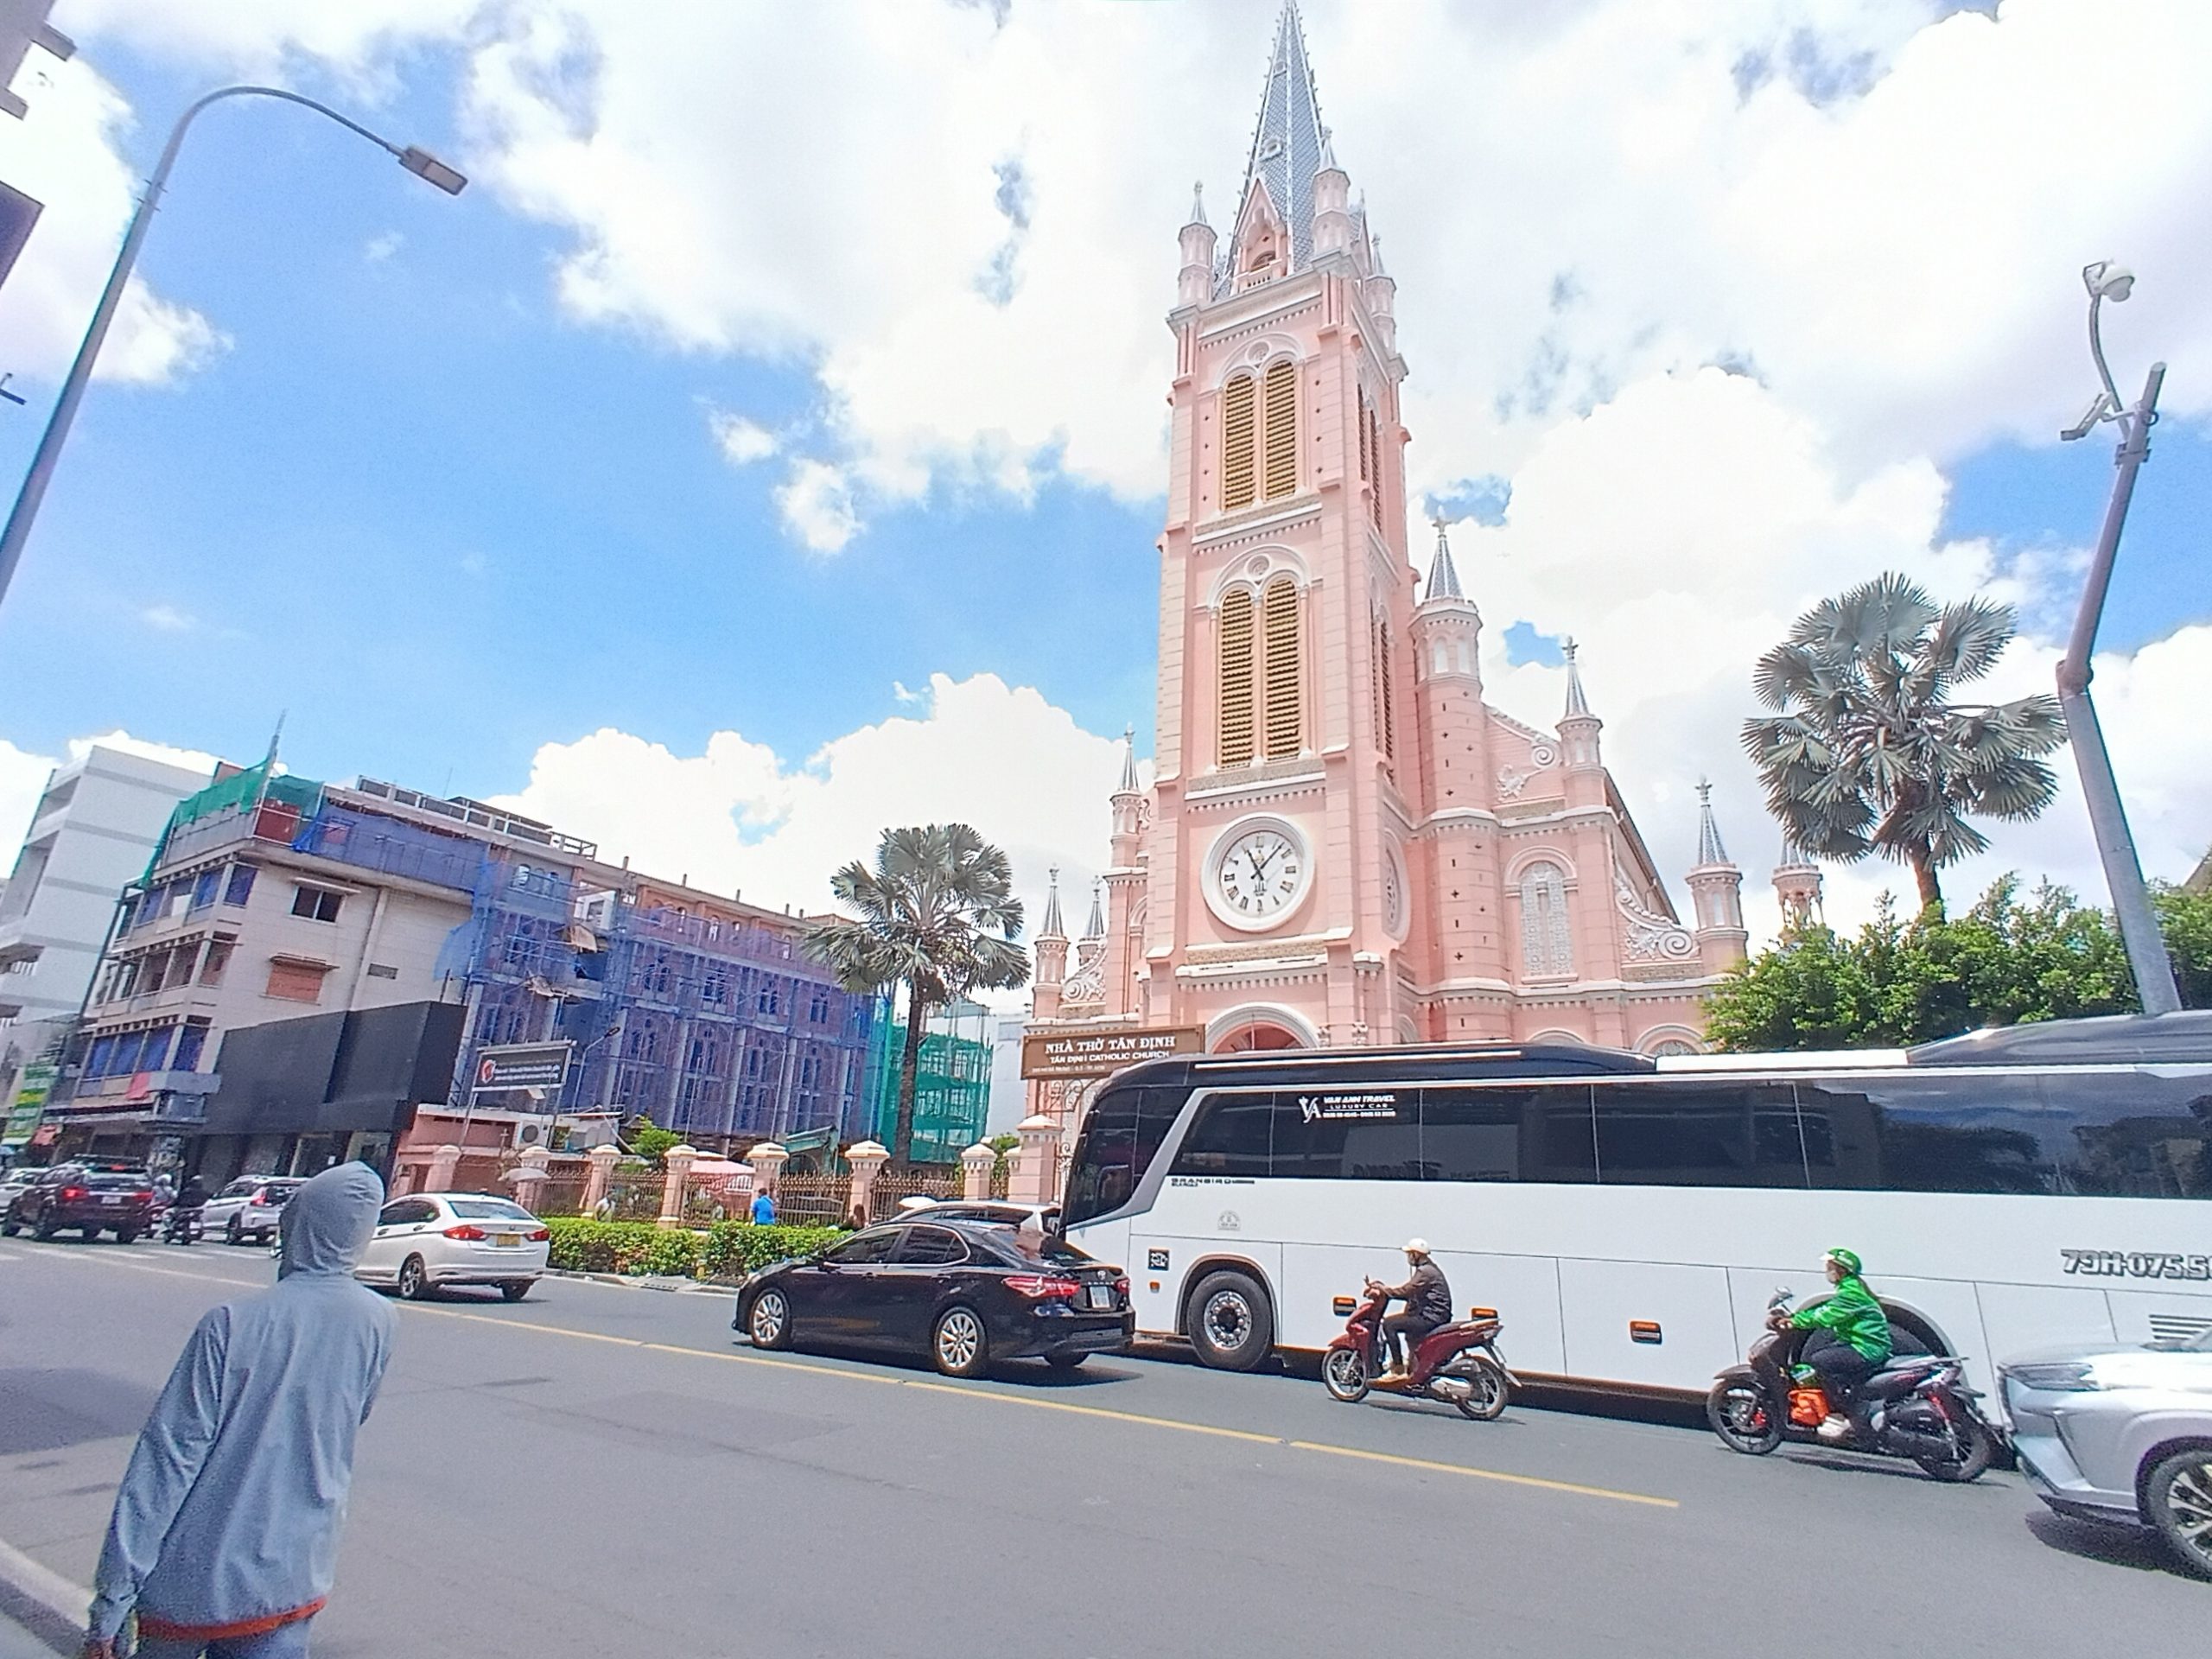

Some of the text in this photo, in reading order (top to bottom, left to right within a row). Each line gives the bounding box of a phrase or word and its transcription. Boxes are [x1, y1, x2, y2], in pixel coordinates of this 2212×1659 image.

[1046, 1037, 1175, 1053] NHÀ THỜ TÂN ĐỊNH
[1090, 1052, 1130, 1061] CATHOLIC
[1133, 1050, 1169, 1059] CHURCH
[2060, 1249, 2212, 1281] 79H-075.5
